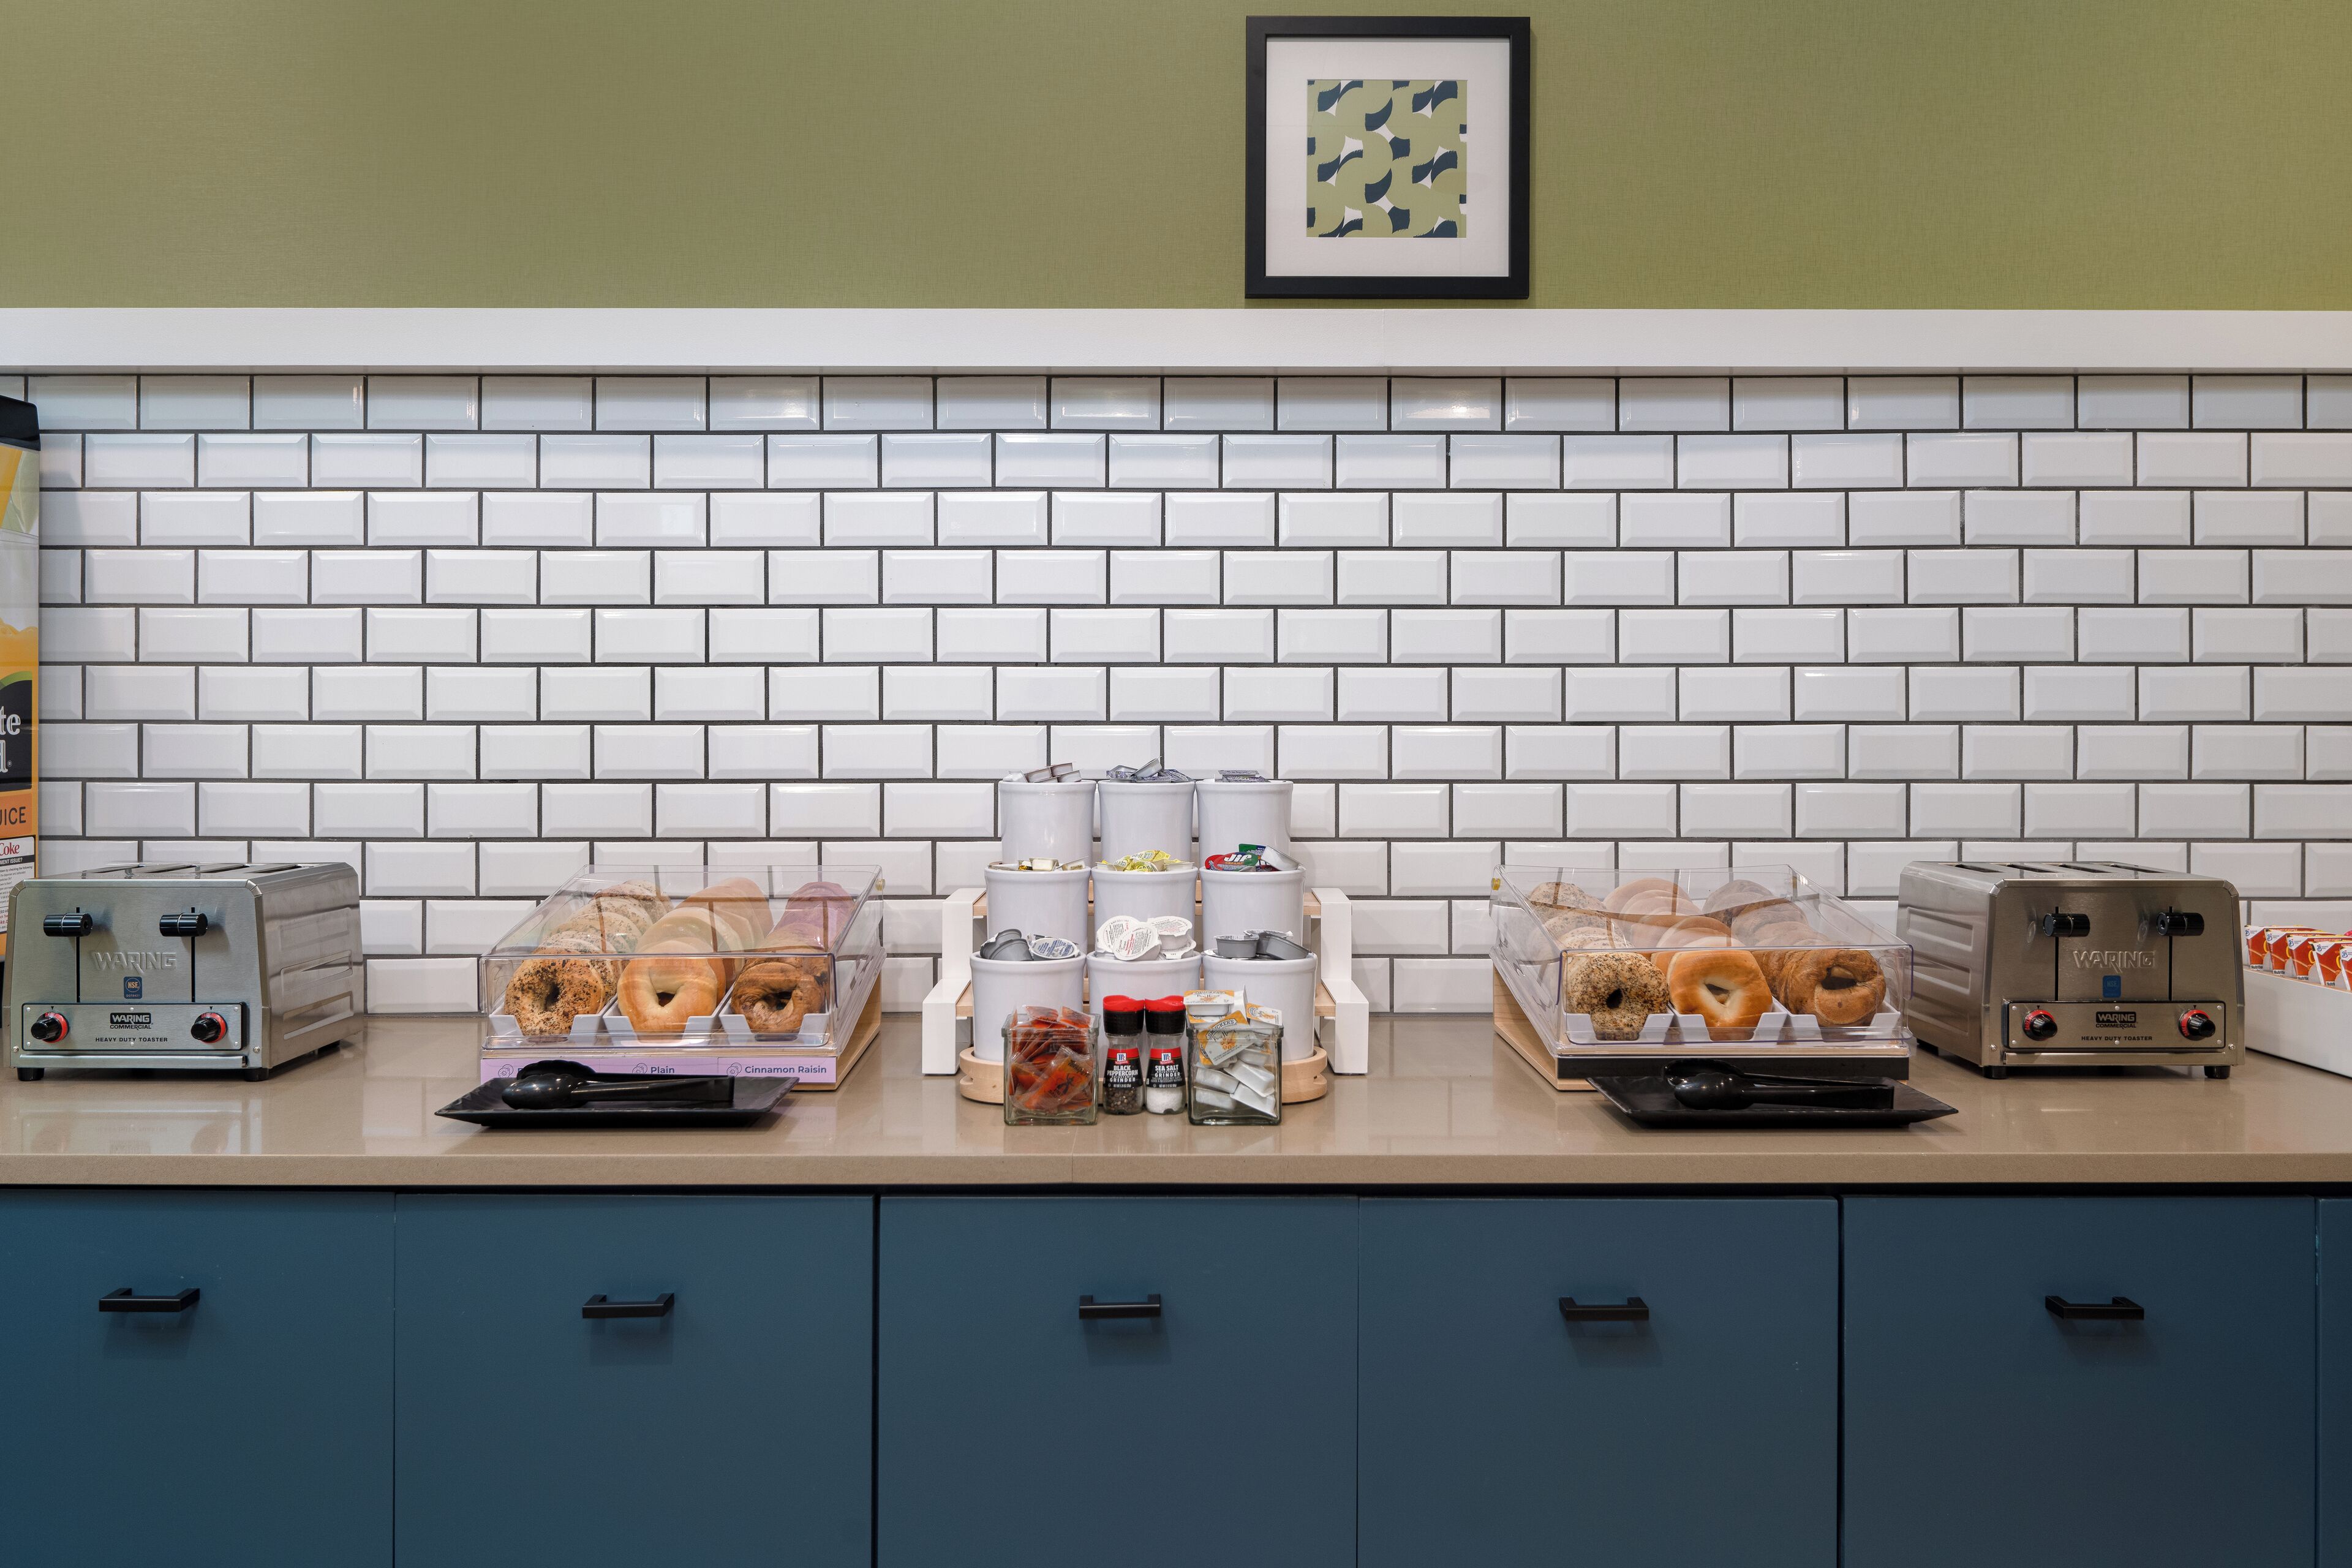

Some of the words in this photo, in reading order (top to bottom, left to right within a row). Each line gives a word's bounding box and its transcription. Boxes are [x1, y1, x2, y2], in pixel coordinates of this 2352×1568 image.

[94, 952, 176, 975] WARING
[2073, 951, 2155, 973] WARING
[112, 1014, 150, 1024] WARING
[2098, 1014, 2135, 1023] WARING
